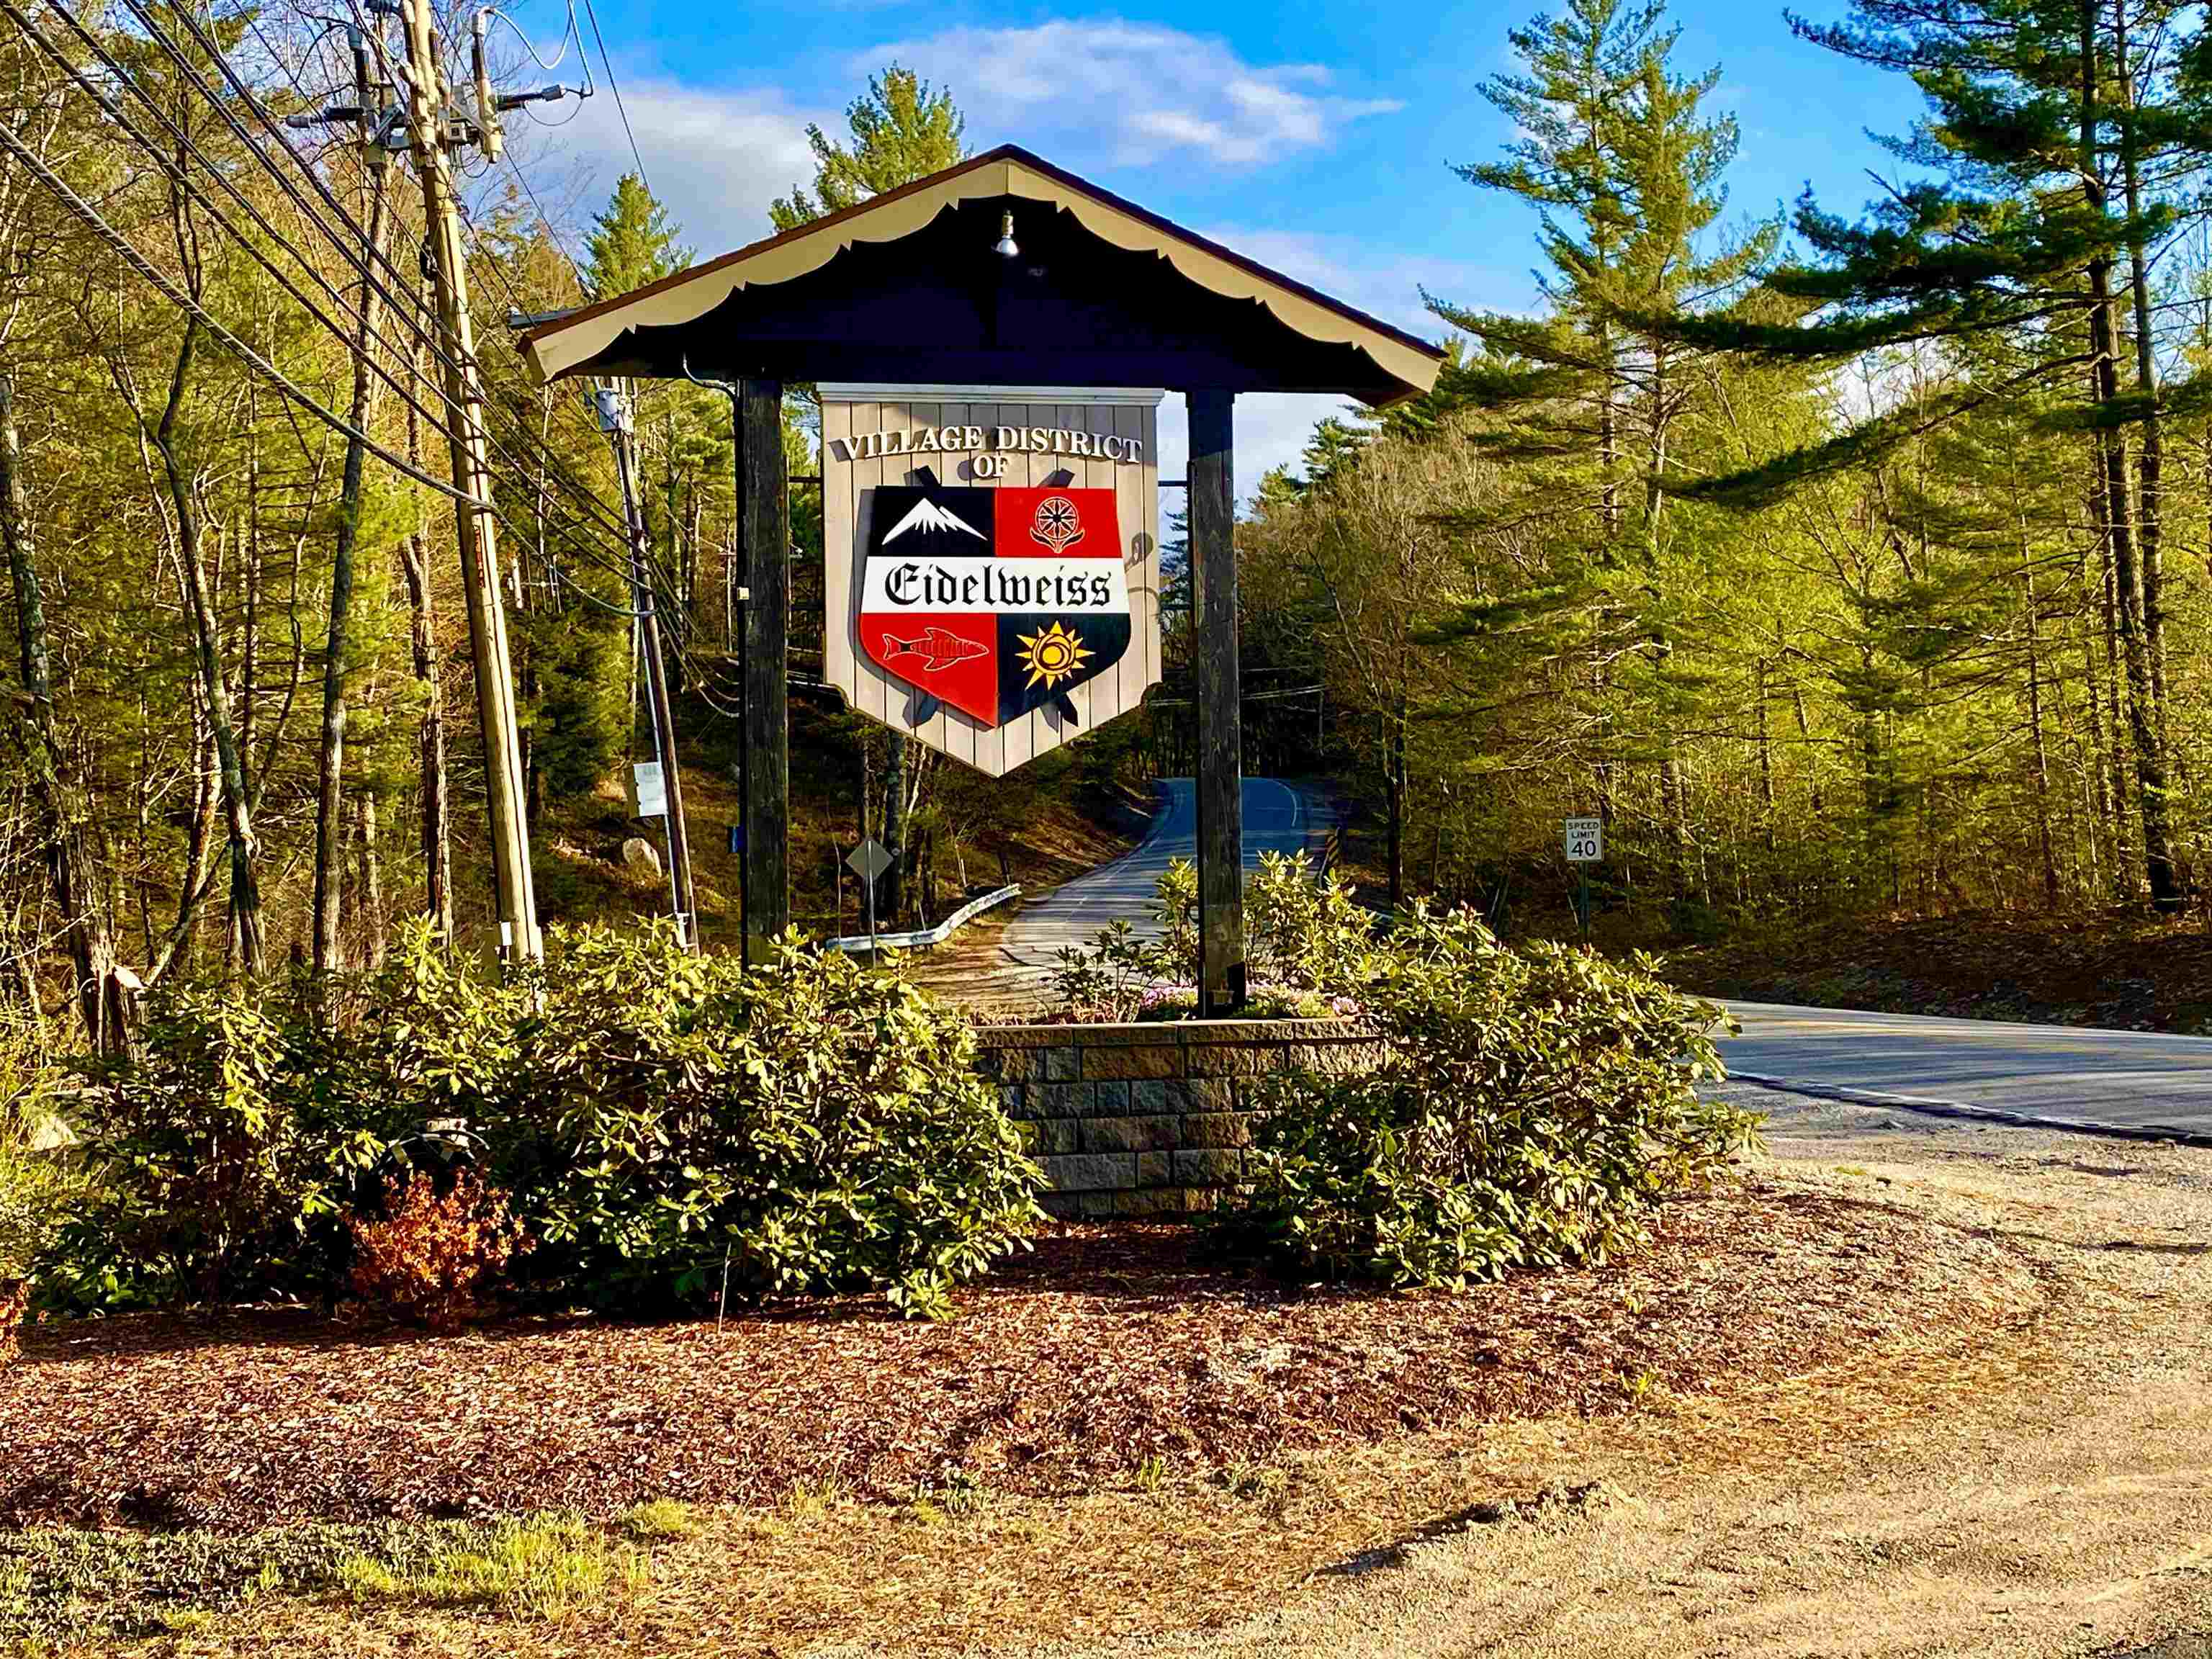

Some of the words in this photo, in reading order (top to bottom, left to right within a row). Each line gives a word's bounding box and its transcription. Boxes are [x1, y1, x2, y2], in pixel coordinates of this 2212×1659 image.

[841, 426, 983, 460] VILLAGE
[996, 426, 1143, 464] DISTRICT
[973, 454, 1009, 477] OF
[885, 562, 1112, 606] Eidelweiss
[1571, 840, 1596, 857] 40
